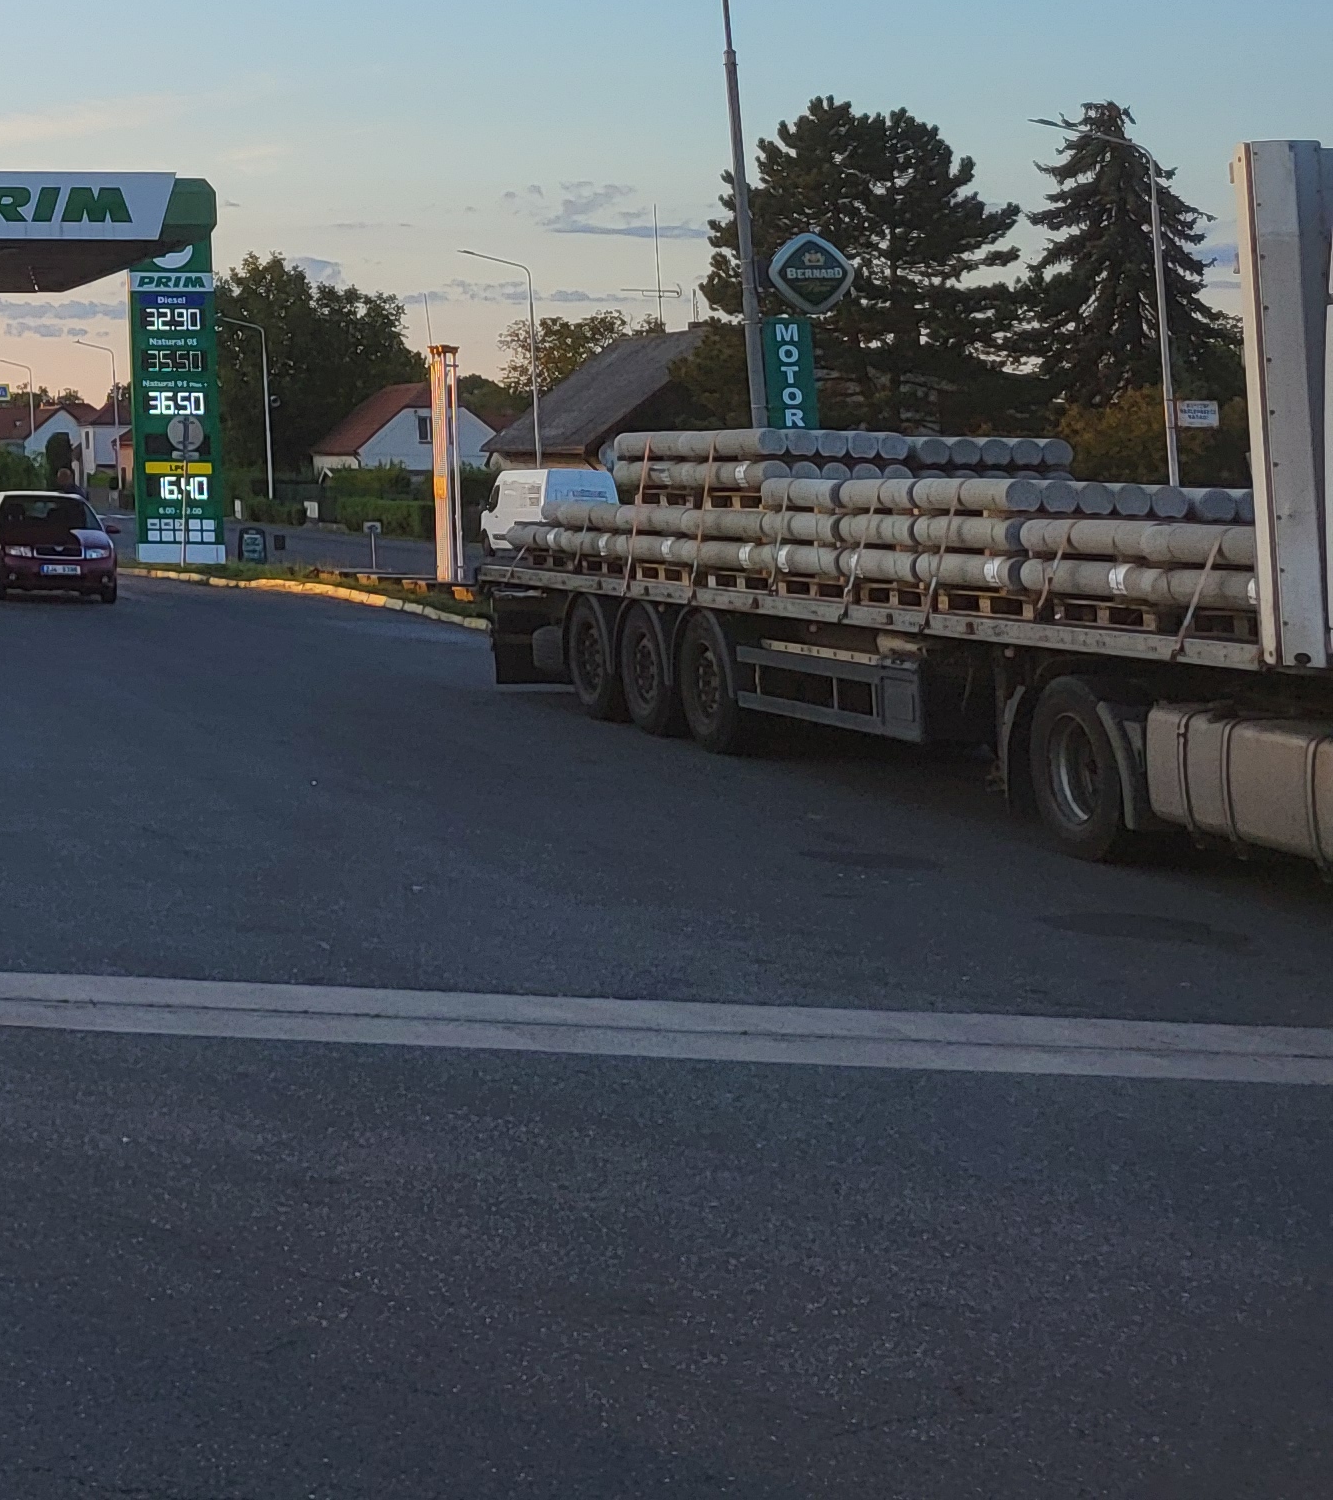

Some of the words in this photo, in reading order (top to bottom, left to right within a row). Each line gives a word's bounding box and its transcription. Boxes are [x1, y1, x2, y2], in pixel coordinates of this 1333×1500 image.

[137, 275, 206, 288] PRIM
[786, 267, 843, 279] BERNARD
[157, 296, 186, 304] Diesel
[145, 308, 201, 331] 32.90
[148, 338, 185, 346] Natural
[186, 338, 198, 346] 95
[147, 350, 202, 372] 35.50
[775, 323, 806, 427] MOTOR
[142, 380, 175, 388] Natural
[176, 380, 188, 388] 95
[148, 391, 205, 415] 36.50
[160, 476, 208, 500] 16.40
